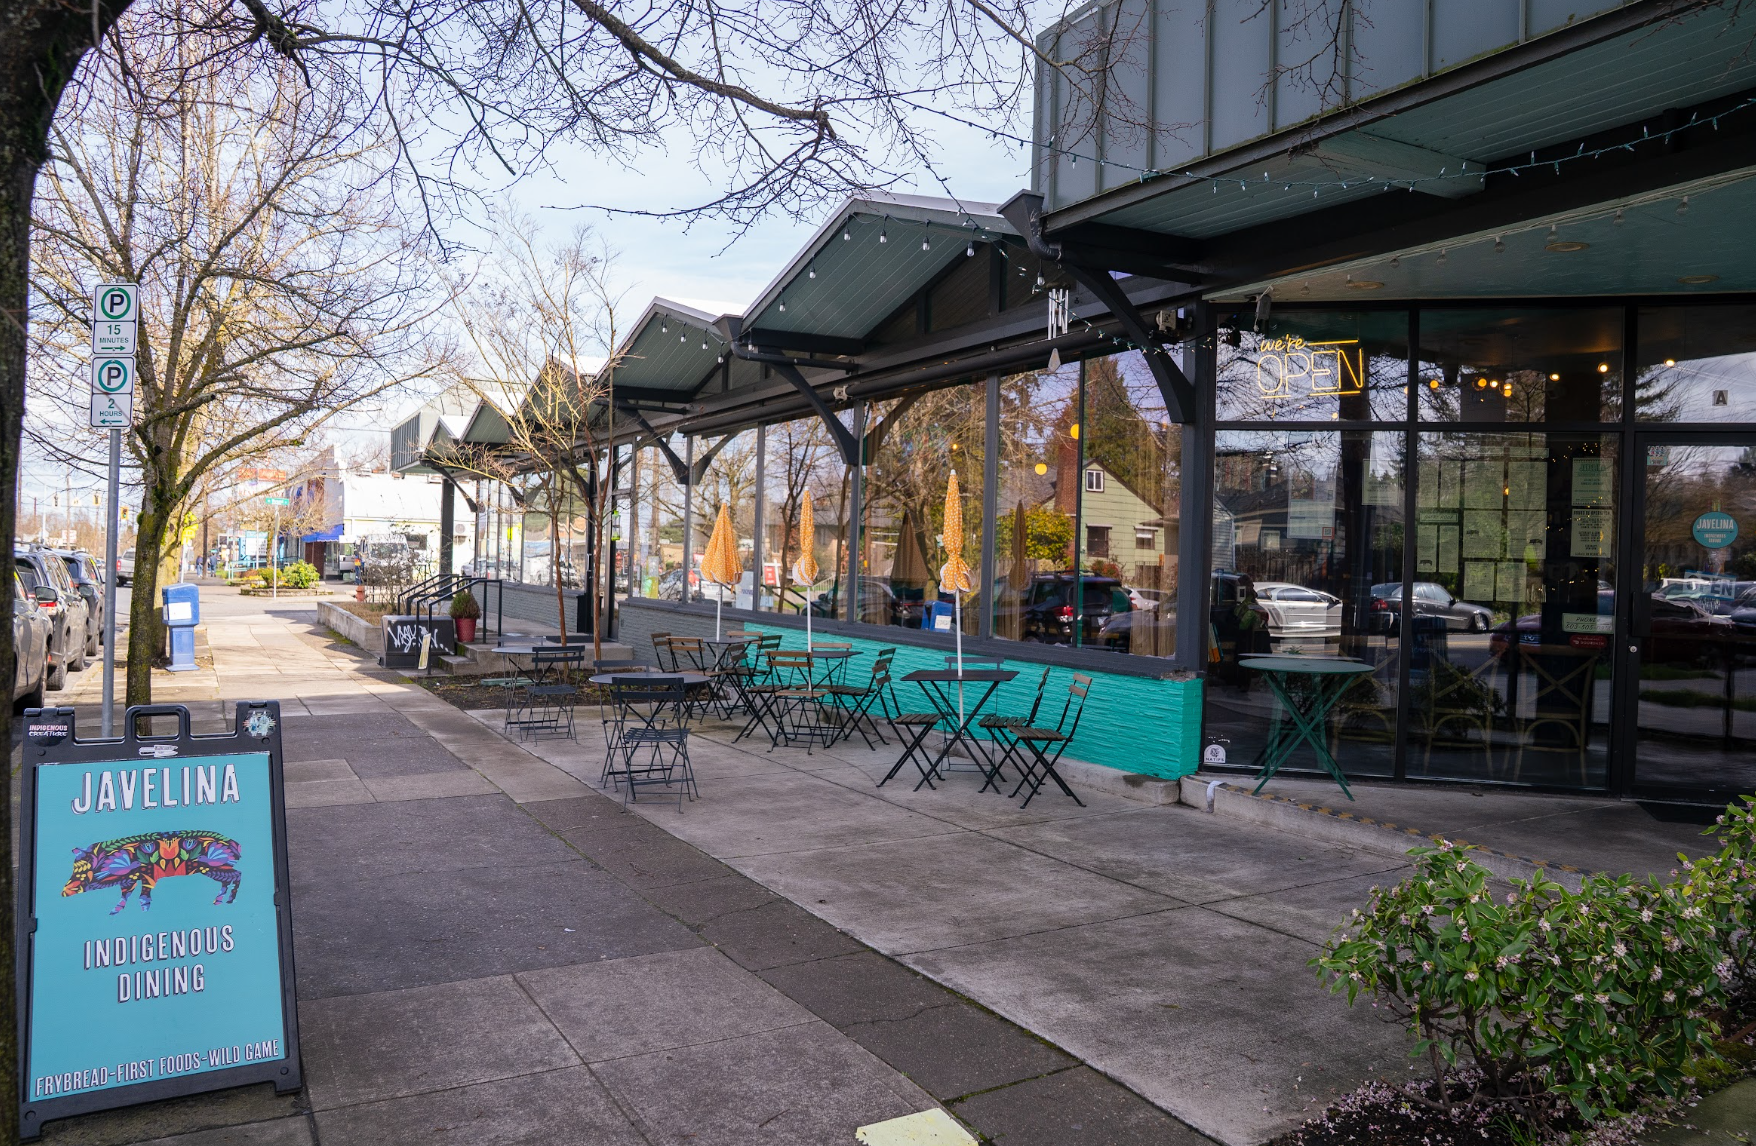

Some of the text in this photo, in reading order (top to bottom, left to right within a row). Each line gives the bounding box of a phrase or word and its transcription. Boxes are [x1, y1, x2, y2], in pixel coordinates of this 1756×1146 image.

[109, 293, 125, 313] P
[107, 324, 121, 336] 15
[1260, 334, 1305, 353] we're
[106, 366, 122, 386] P
[1257, 348, 1364, 393] OPEN
[107, 398, 115, 409] 2
[1715, 390, 1728, 405] A
[1696, 518, 1734, 530] JAVELINA
[1686, 574, 1733, 597] OPEN
[71, 763, 240, 815] JAVELINA
[84, 924, 235, 970] INDIGENOUS
[117, 963, 205, 1004] DINING
[245, 1038, 279, 1061] GAME
